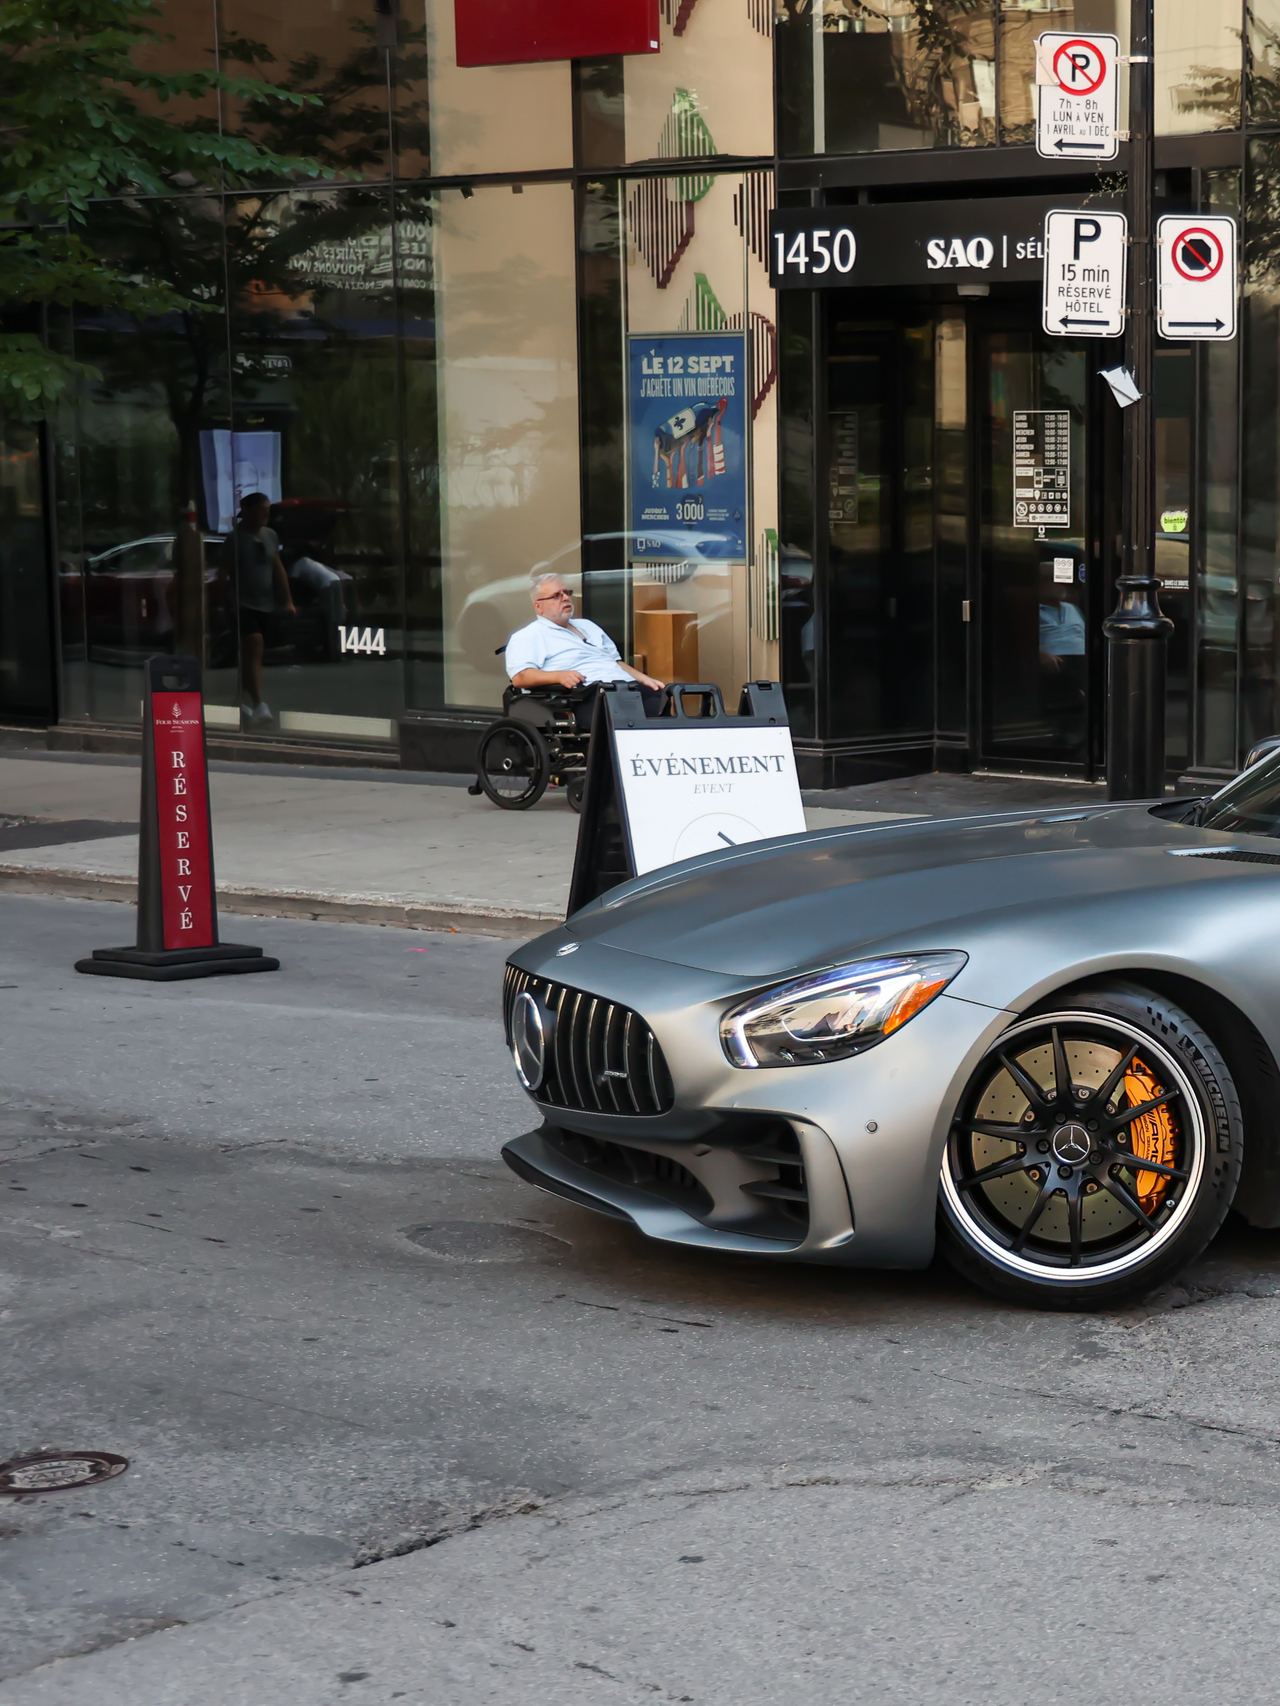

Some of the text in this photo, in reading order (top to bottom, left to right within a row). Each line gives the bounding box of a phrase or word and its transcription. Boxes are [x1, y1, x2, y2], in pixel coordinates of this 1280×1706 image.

[1059, 98, 1071, 109] 7h
[1085, 99, 1098, 110] 8h
[1053, 111, 1072, 122] LUN
[1084, 112, 1104, 123] VEN
[1053, 124, 1075, 135] AVRIL
[1095, 123, 1110, 137] DÉC
[1073, 218, 1101, 260] P
[774, 229, 857, 275] 1450
[927, 237, 994, 269] SAQ
[1061, 264, 1110, 282] 15 min
[1058, 284, 1111, 299] RÉSERVÉ
[1065, 299, 1104, 313] HÔTEL
[642, 355, 734, 374] LE 12 SEPT.
[673, 378, 683, 396] UN
[684, 378, 696, 396] VIN
[697, 373, 735, 396] QUÉBÉCOIS
[338, 626, 386, 655] 1444
[630, 753, 786, 777] ÉVÉNEMENT
[693, 782, 735, 794] EVENT
[172, 751, 193, 930] RÉSERVÉ
[1193, 1058, 1230, 1152] MICHELIN
